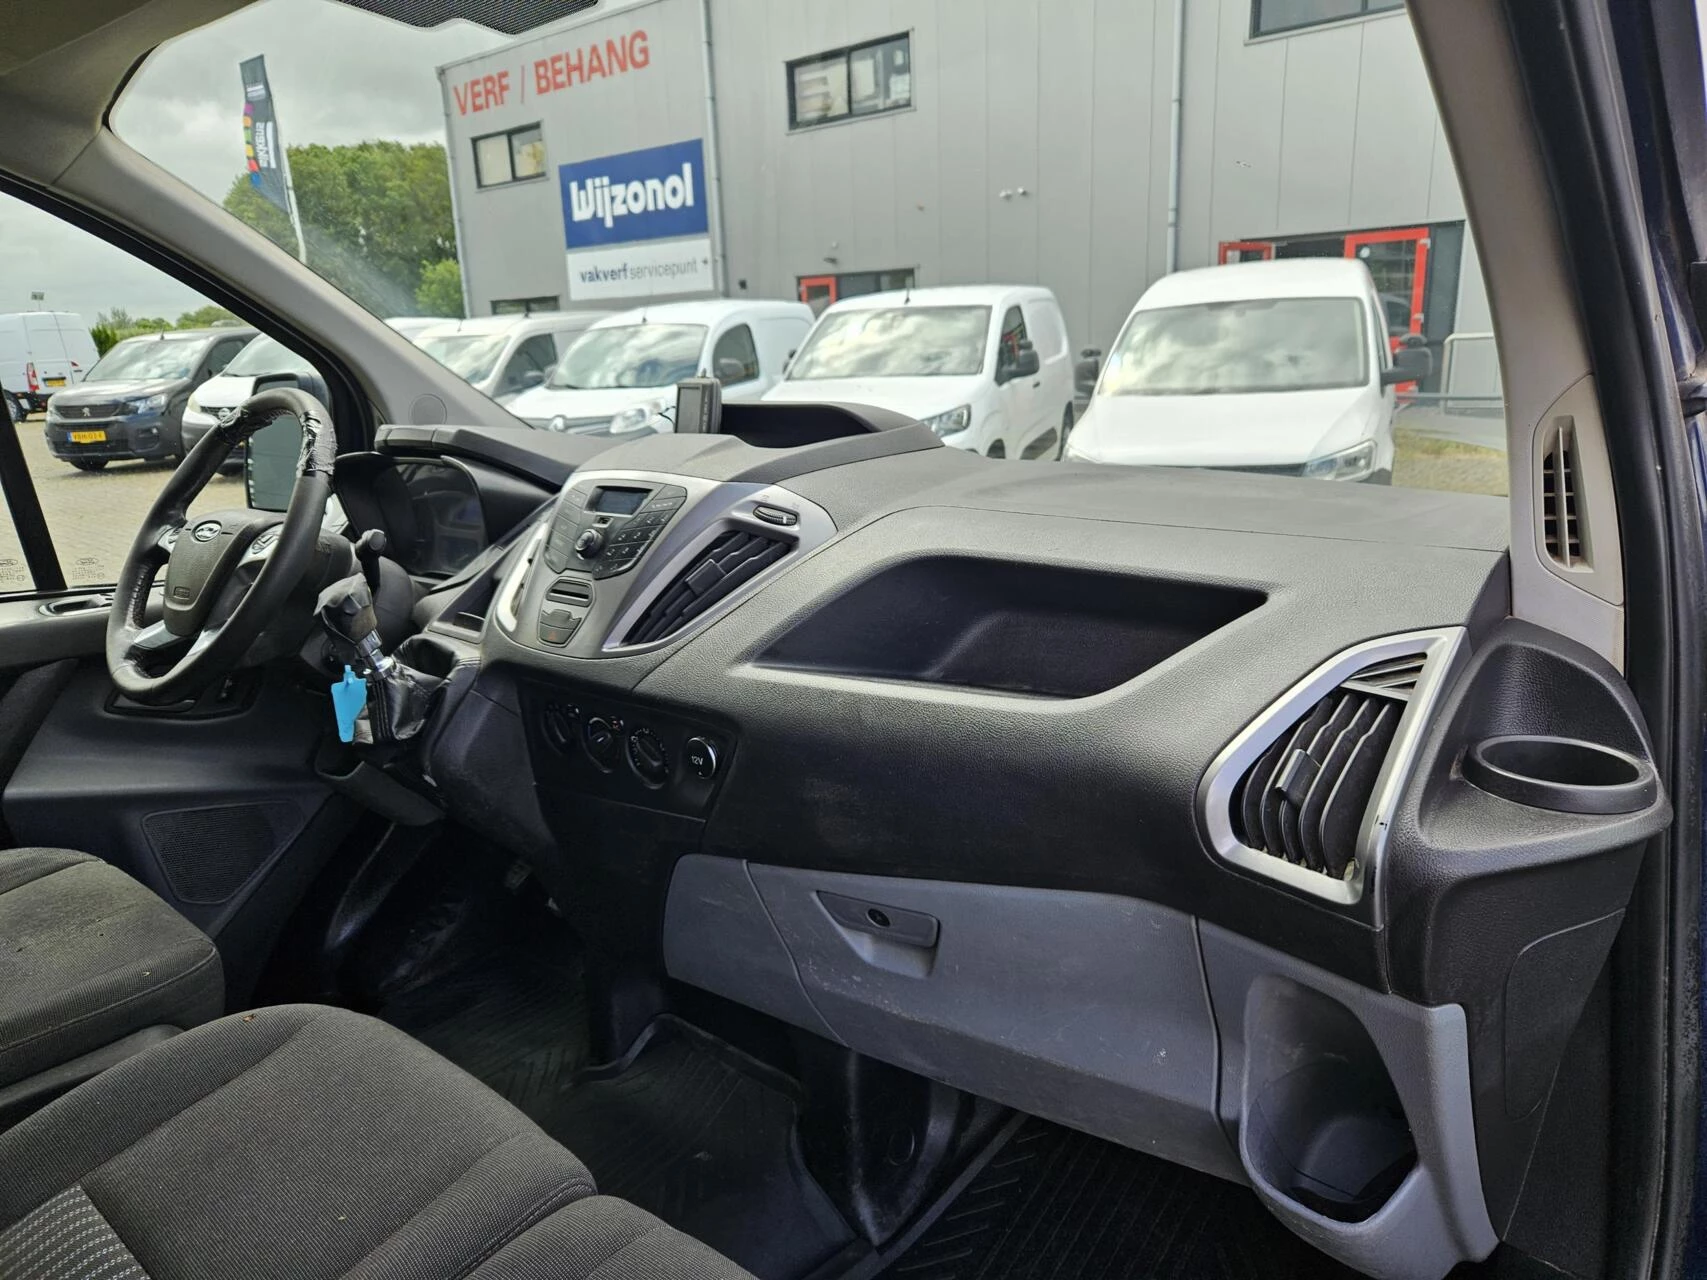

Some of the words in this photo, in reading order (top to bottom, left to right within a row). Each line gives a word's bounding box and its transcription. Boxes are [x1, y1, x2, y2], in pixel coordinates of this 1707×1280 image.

[453, 70, 511, 116] VERF
[520, 64, 525, 104] /
[533, 29, 650, 96] BEHANG
[569, 162, 694, 229] Wijzonol
[690, 755, 704, 766] 12V
